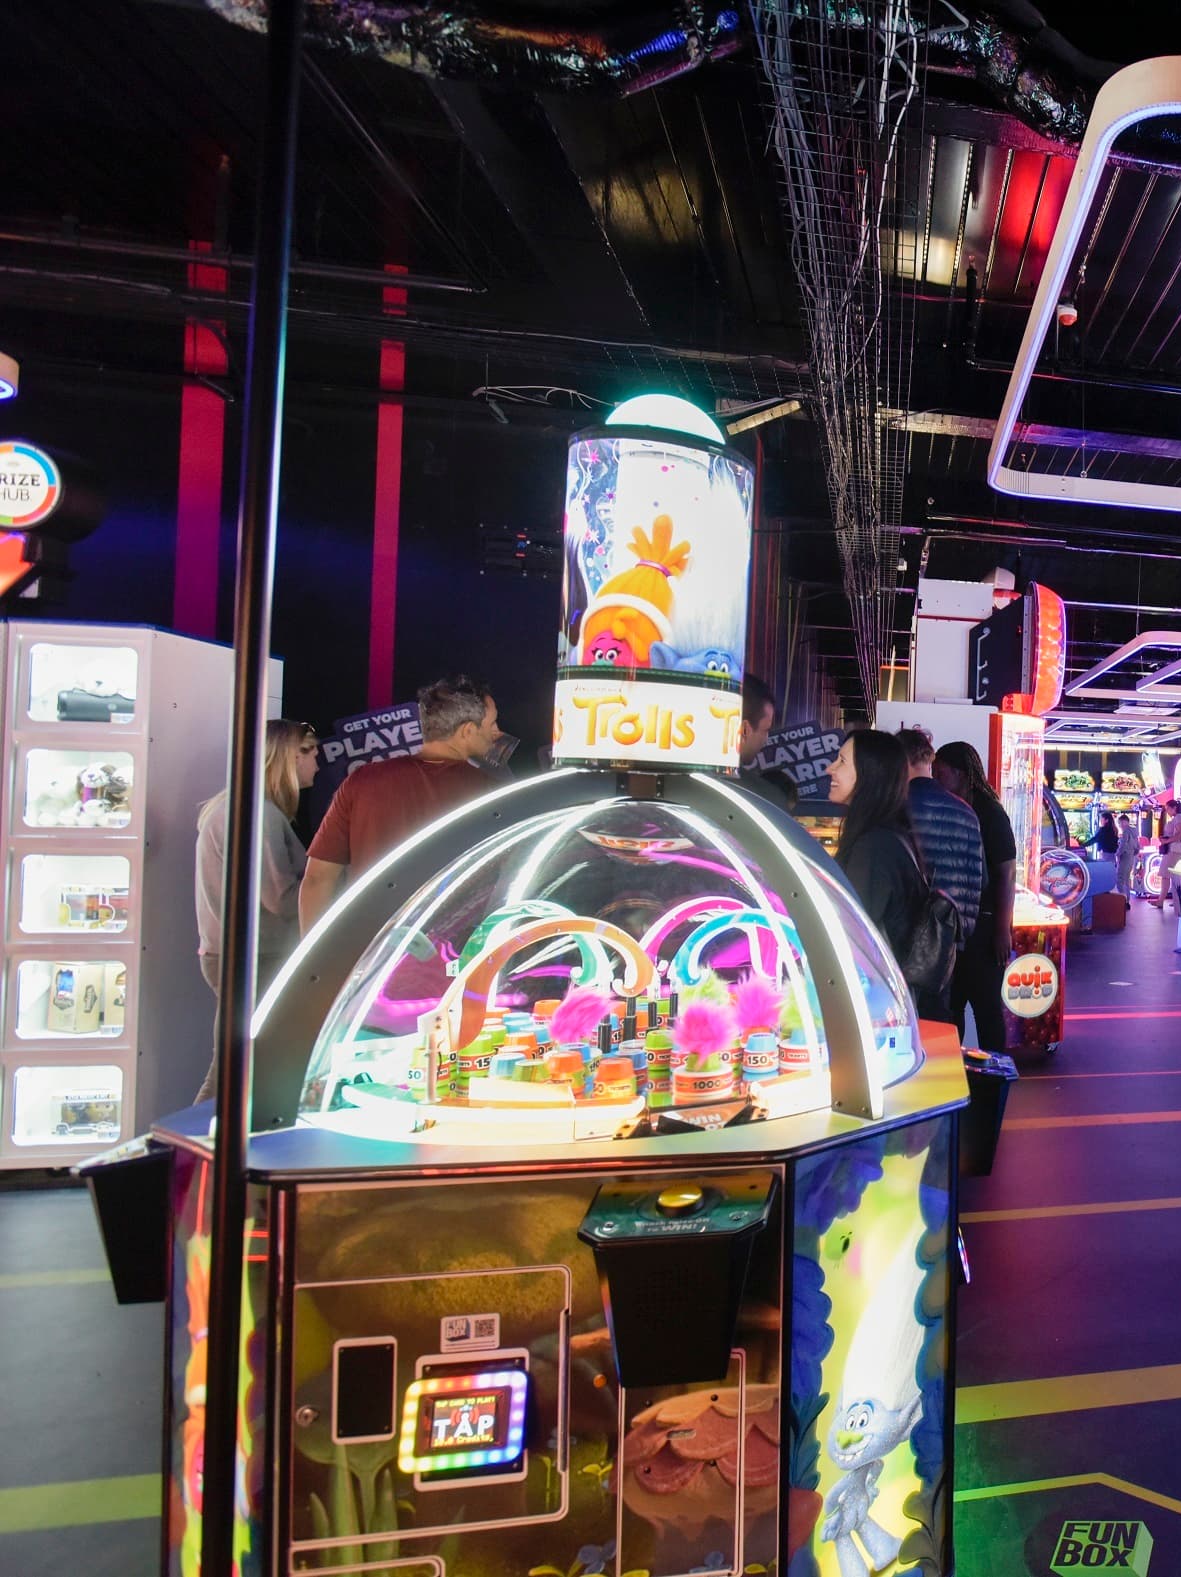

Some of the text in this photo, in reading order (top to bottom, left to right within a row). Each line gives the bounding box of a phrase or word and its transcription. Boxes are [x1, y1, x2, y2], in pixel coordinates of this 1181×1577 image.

[343, 708, 413, 733] GET YOUR
[573, 695, 695, 750] Trolls
[781, 726, 814, 742] YOUR
[322, 720, 424, 763] PLAYE
[747, 1055, 768, 1066] 150
[433, 1414, 495, 1441] TAP
[1063, 1522, 1140, 1549] FUN
[1053, 1538, 1133, 1567] BOX
